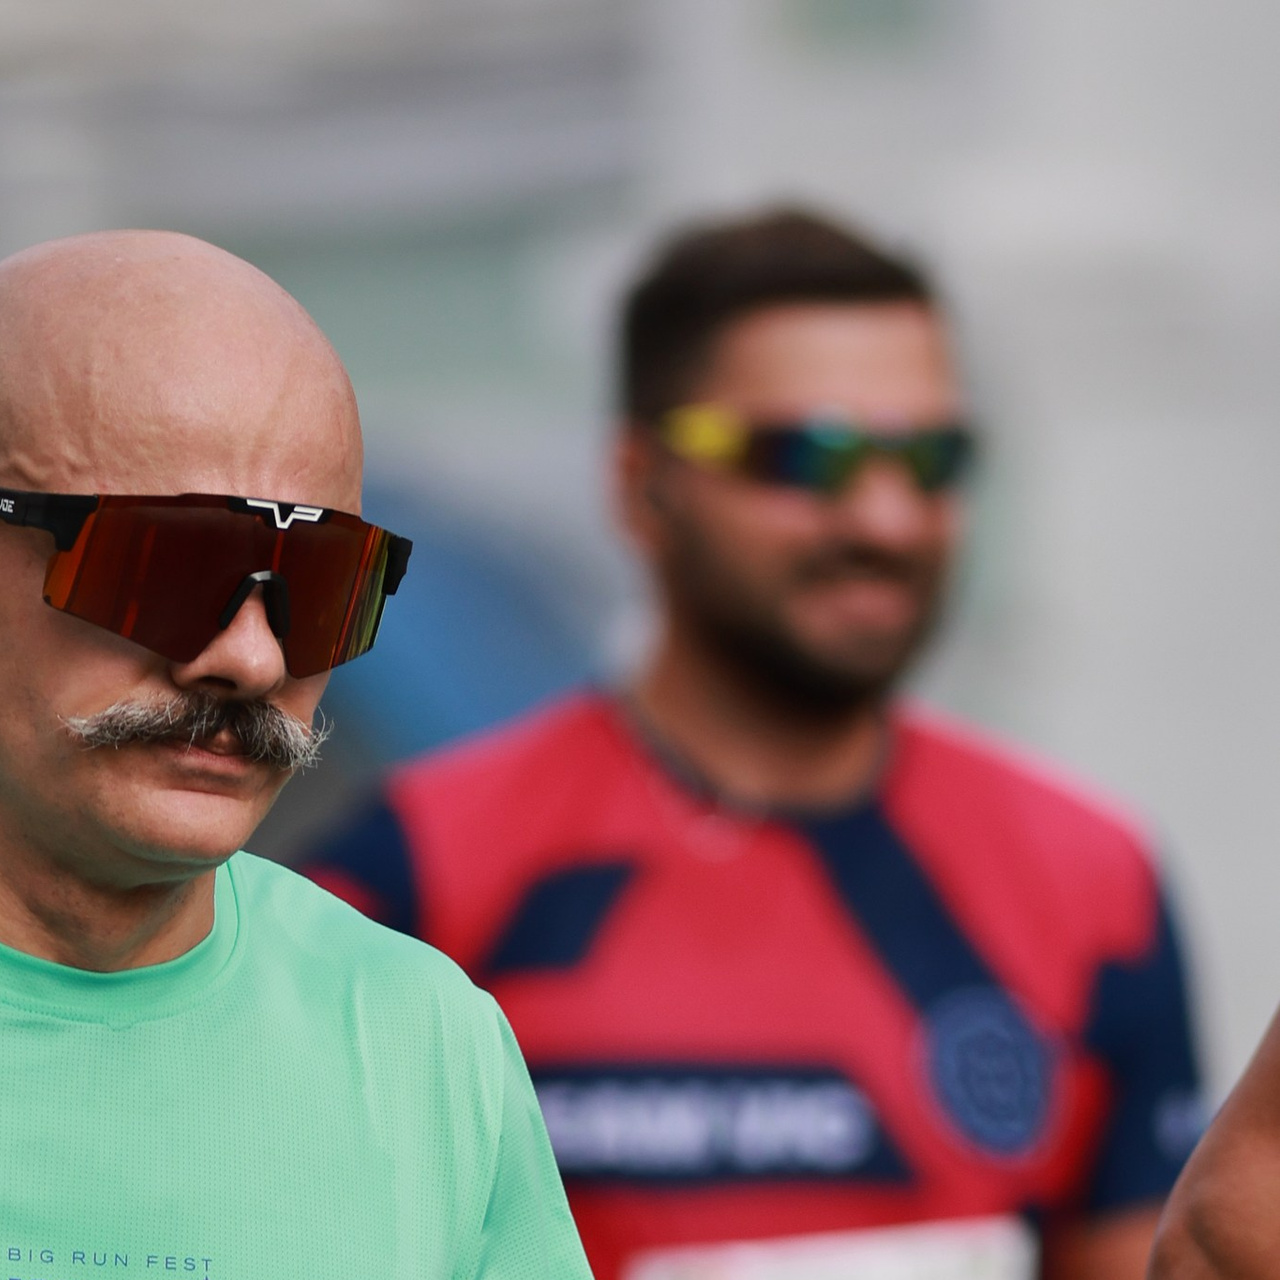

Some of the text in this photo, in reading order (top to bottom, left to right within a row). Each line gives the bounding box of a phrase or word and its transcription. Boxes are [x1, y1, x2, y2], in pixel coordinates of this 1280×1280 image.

[8, 1247, 213, 1272] BIG RUN FEST
